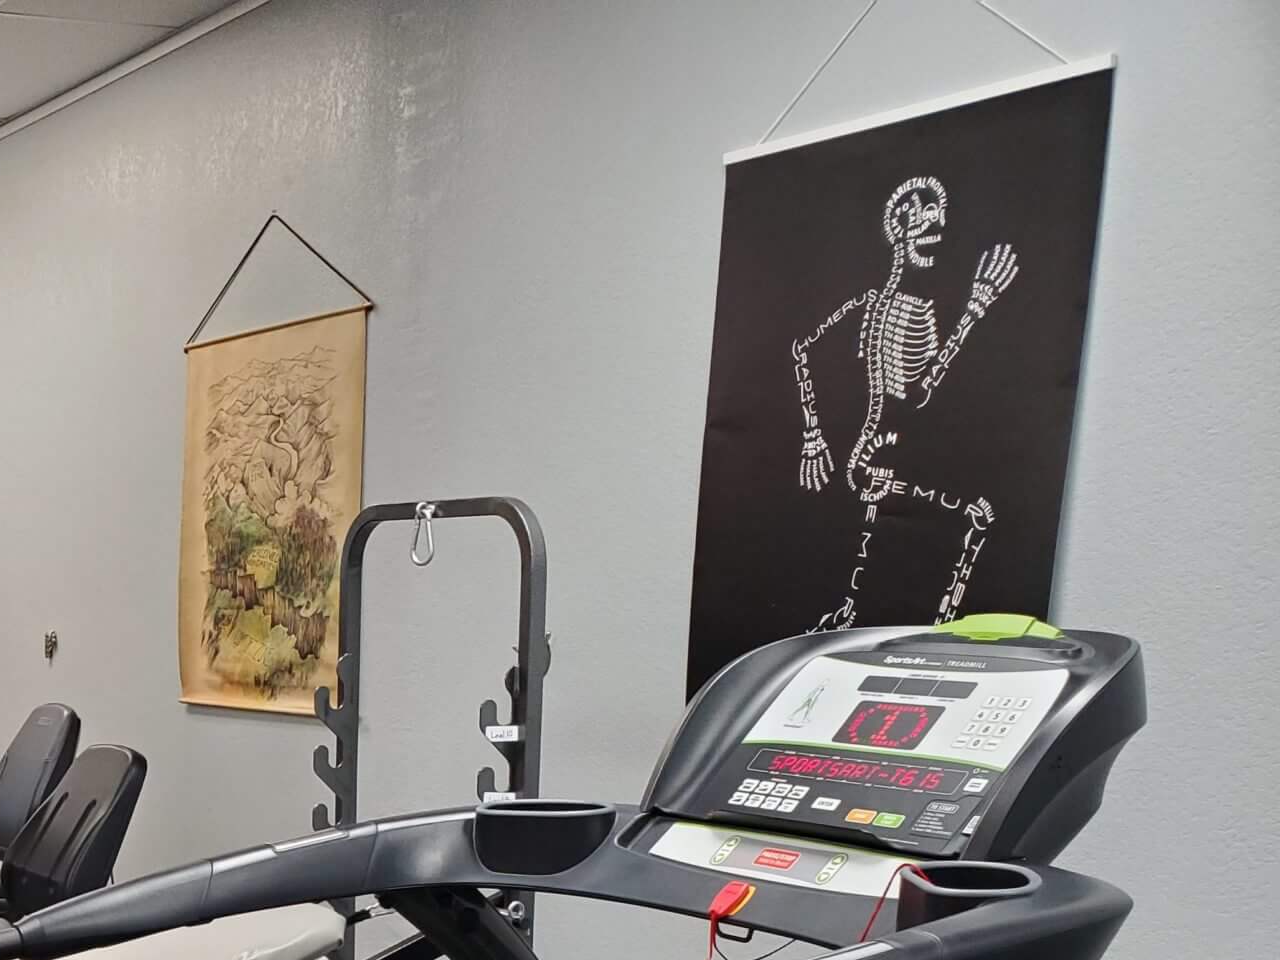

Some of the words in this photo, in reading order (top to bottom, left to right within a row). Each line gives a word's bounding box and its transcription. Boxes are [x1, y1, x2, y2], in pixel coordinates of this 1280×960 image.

[886, 177, 927, 208] PARIETAL
[858, 431, 897, 468] ILIUM
[866, 467, 894, 478] PUBIS
